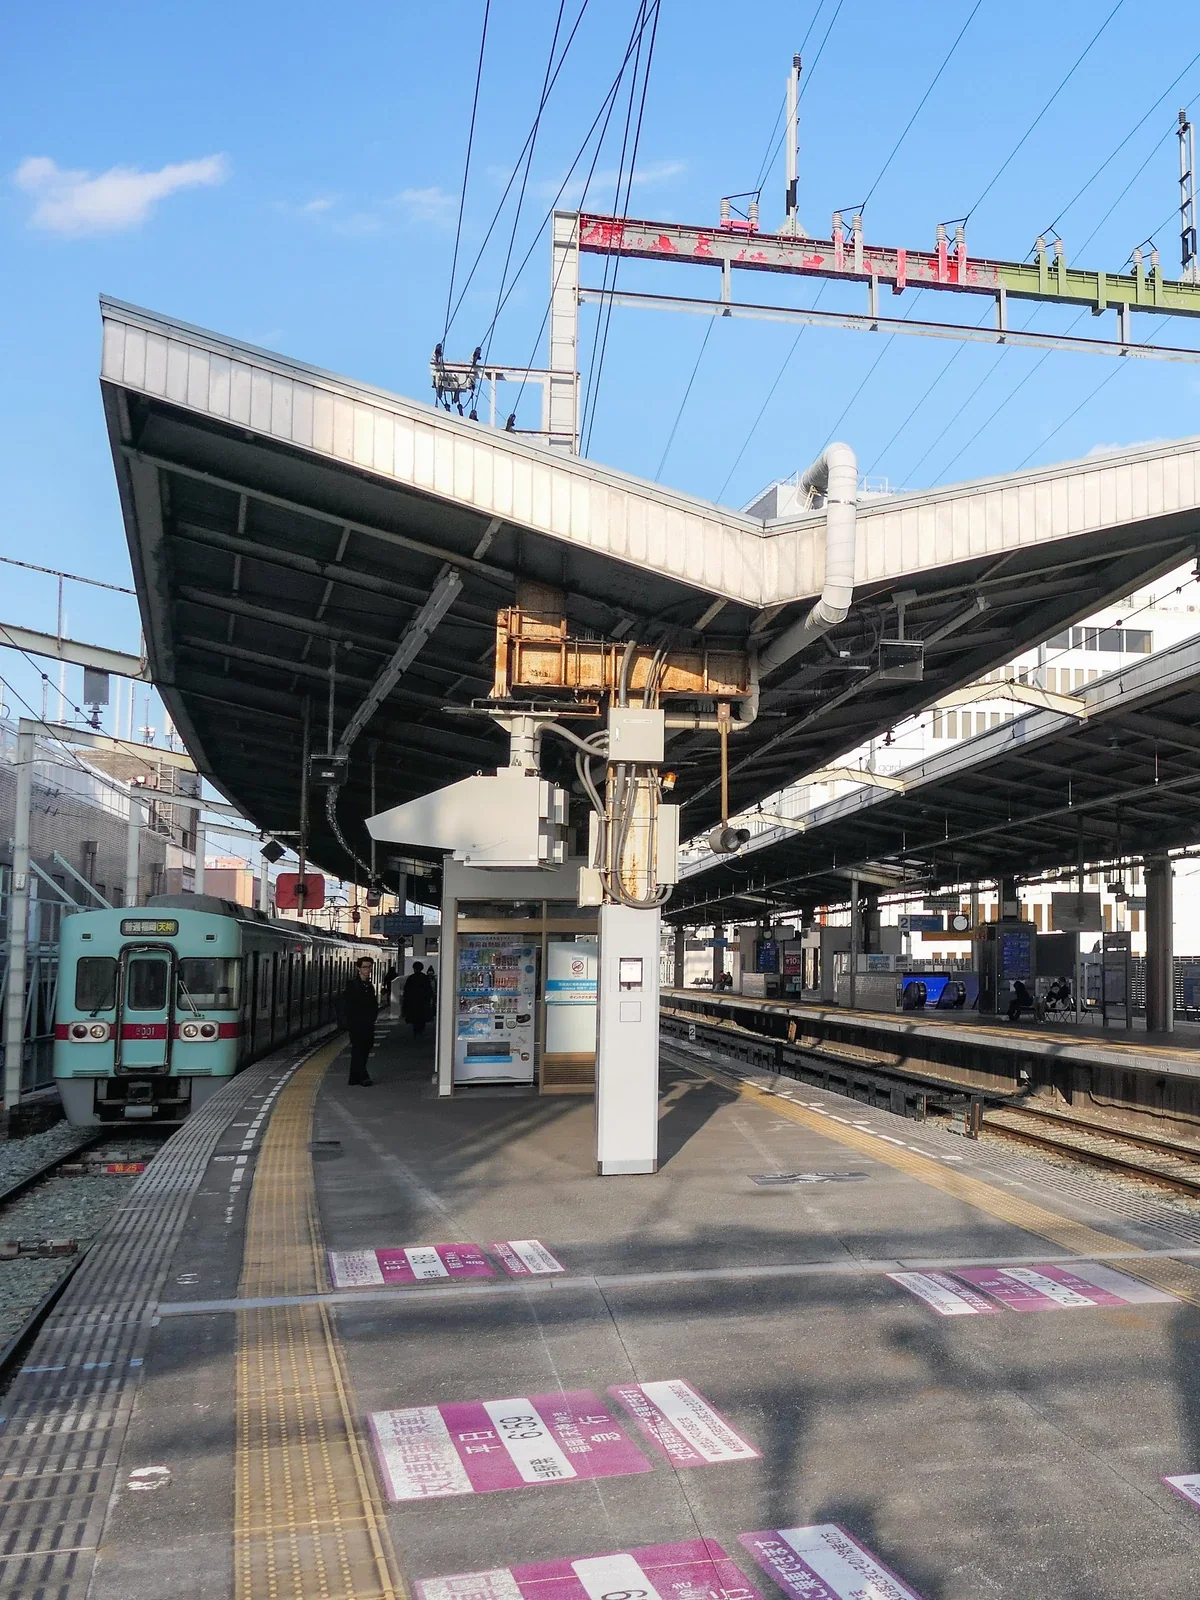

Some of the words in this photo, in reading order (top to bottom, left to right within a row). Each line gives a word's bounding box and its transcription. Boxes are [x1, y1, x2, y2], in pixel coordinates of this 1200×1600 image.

[373, 920, 381, 931] 4
[900, 917, 909, 929] 2
[689, 1028, 695, 1036] 2
[498, 1414, 543, 1440] 6:59
[578, 1414, 621, 1443] 急行
[458, 1429, 500, 1454] 平日
[529, 1456, 562, 1478] 当駅発
